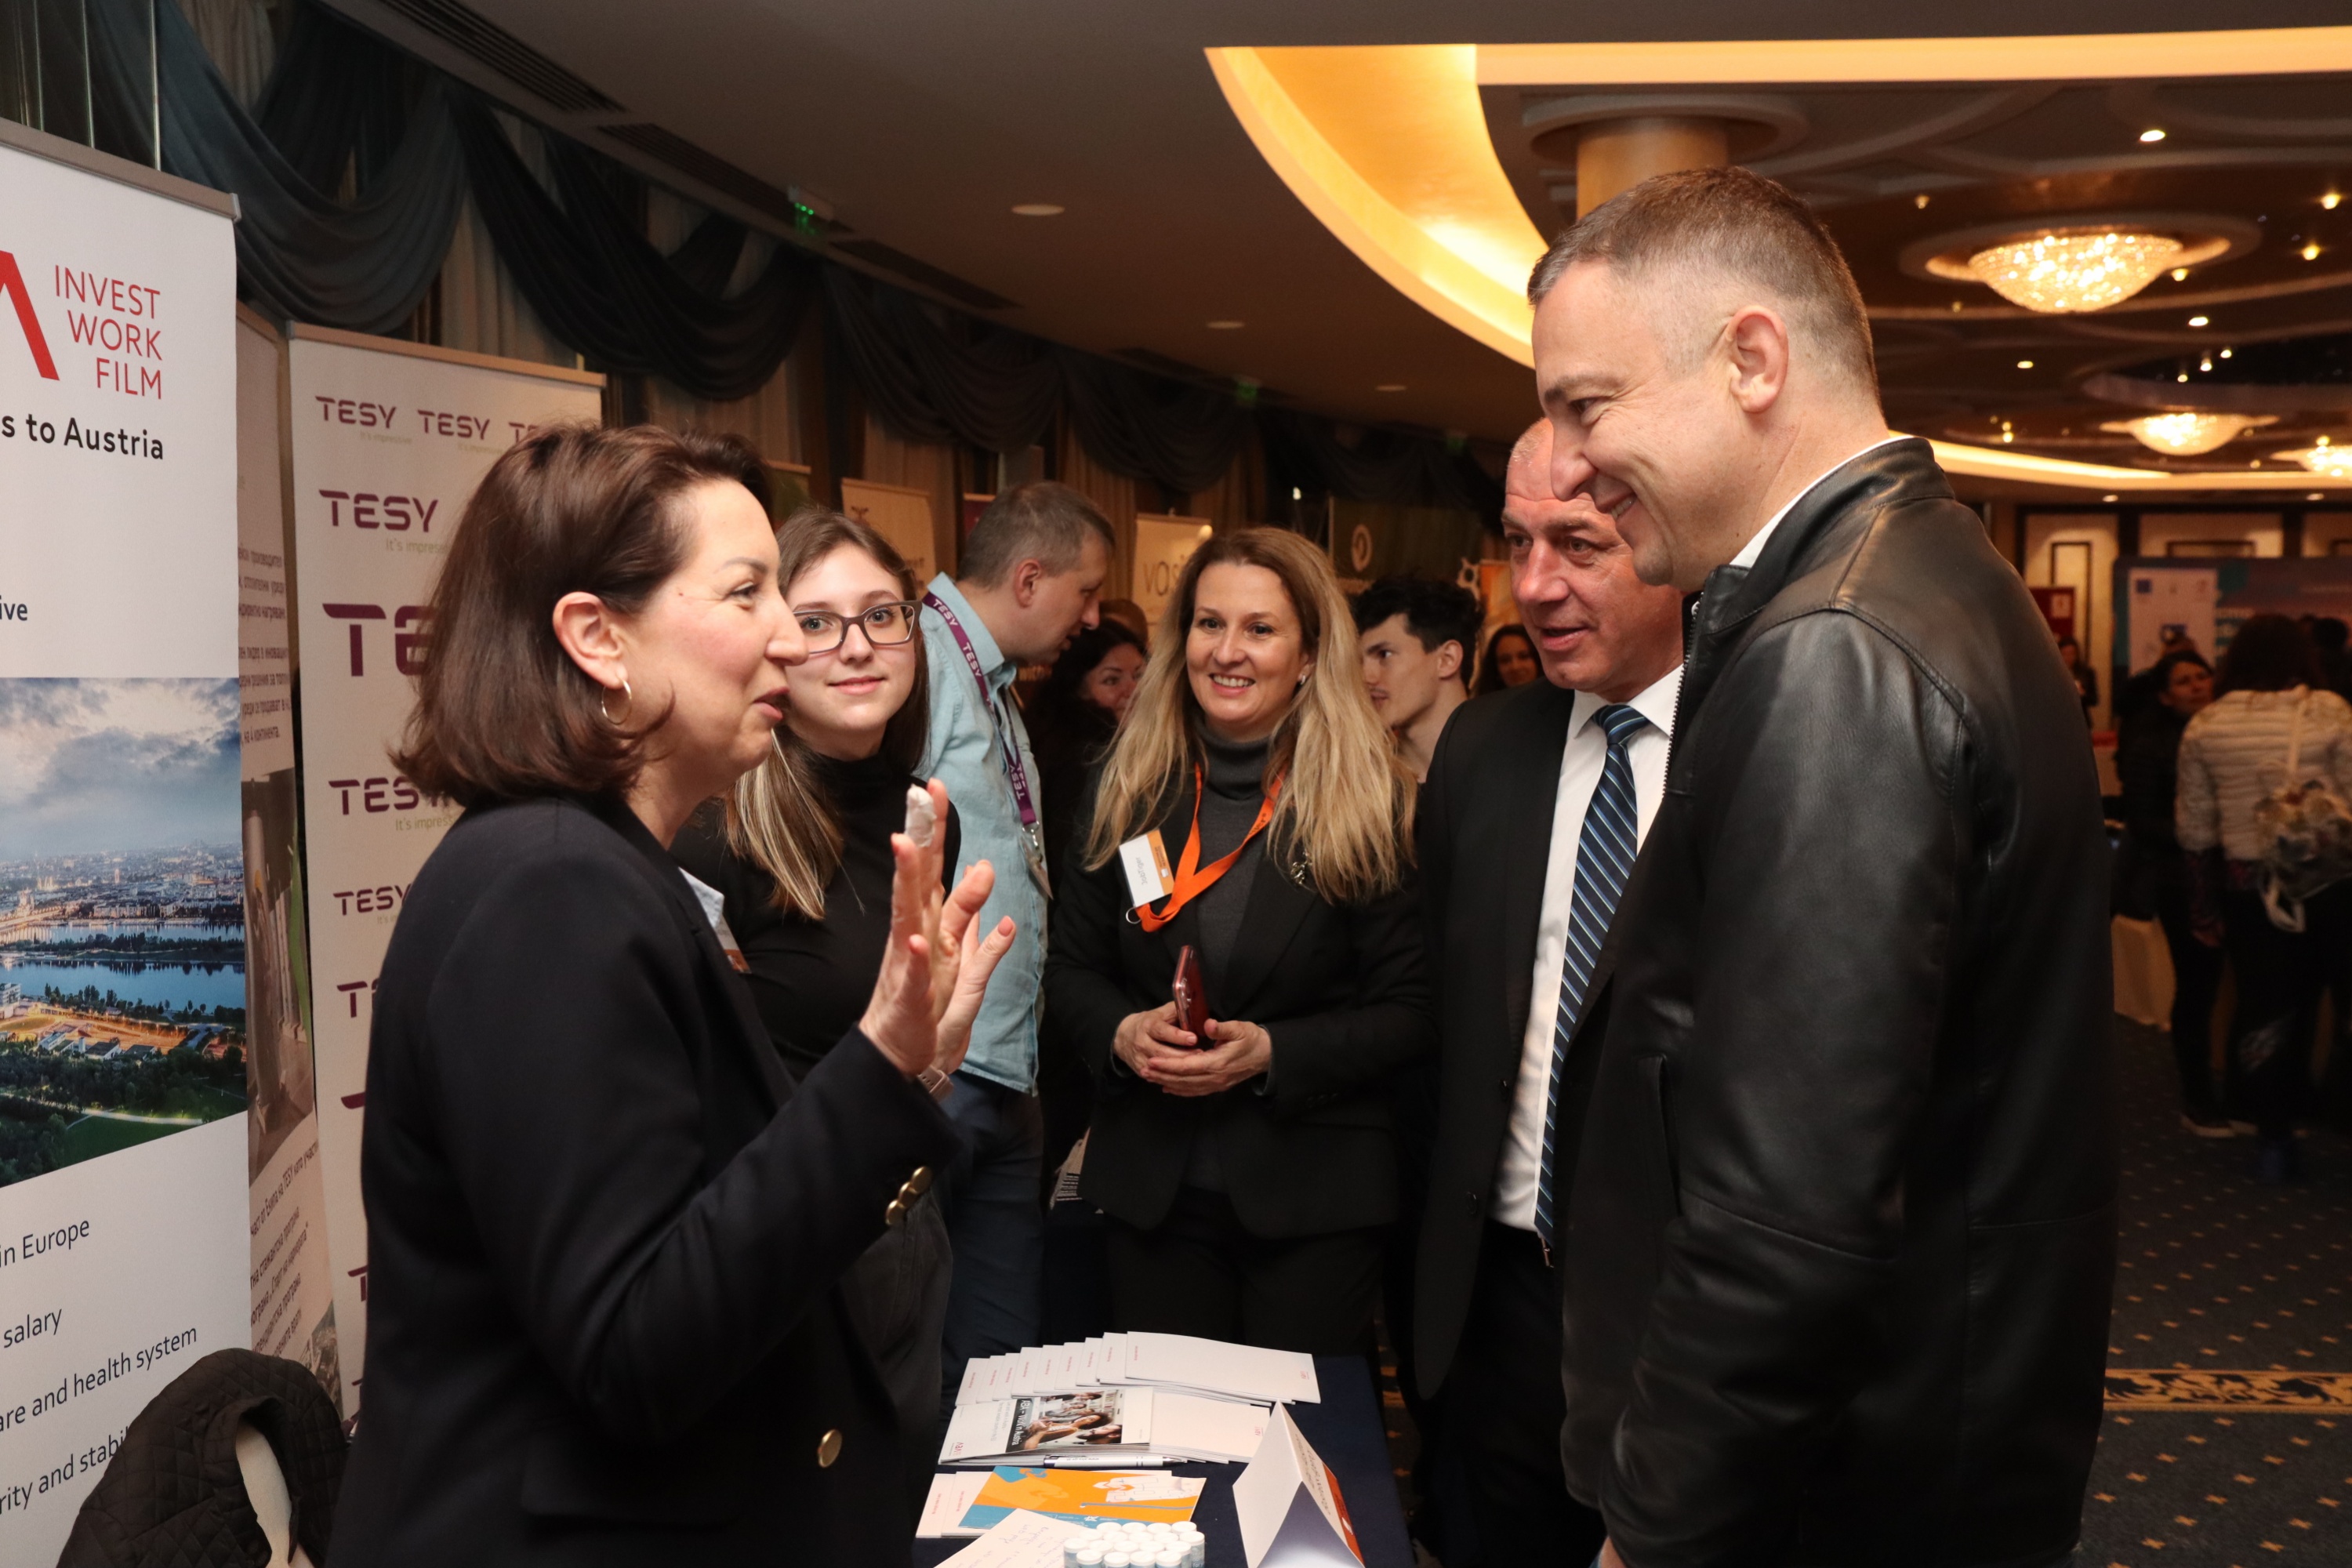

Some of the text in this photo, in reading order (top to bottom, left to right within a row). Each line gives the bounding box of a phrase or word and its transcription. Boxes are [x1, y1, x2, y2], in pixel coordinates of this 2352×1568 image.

[55, 264, 161, 319] INVEST
[67, 309, 162, 361] WORK
[96, 357, 162, 400] FILM
[26, 413, 56, 444] to
[64, 417, 164, 459] Austria
[315, 395, 397, 429] TESY
[417, 409, 490, 441] TESY
[318, 488, 439, 533] TESY
[386, 537, 403, 551] It's
[932, 598, 959, 627] TESY
[963, 642, 982, 677] TESY
[328, 774, 439, 815] TES
[395, 815, 456, 832] It's impress
[23, 1220, 90, 1260] Europe
[3, 1308, 62, 1348] salary
[32, 1377, 67, 1417] and
[74, 1352, 131, 1397] health
[136, 1327, 197, 1370] system
[39, 1454, 74, 1494] and
